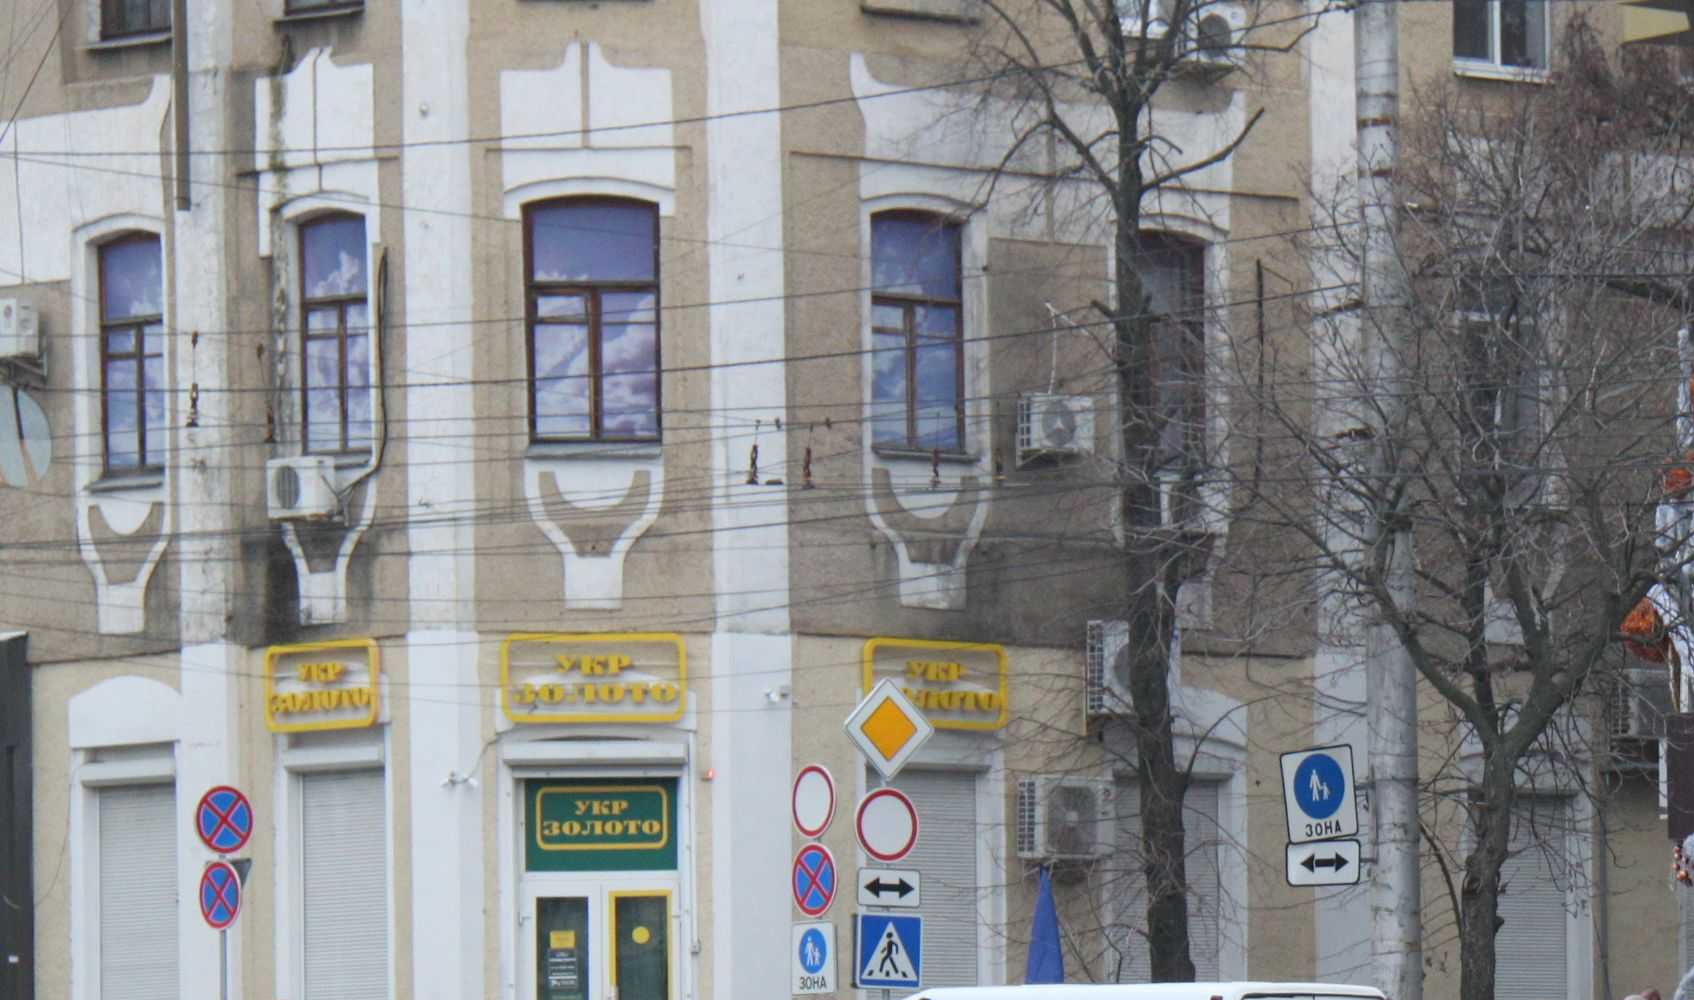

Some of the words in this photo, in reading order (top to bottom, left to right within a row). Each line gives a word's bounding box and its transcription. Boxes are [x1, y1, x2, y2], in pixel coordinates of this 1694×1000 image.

[298, 662, 345, 682] УКР
[553, 655, 634, 676] УКР
[512, 682, 677, 705] ЗОЛОТО
[901, 687, 1000, 713] ЛОТО
[575, 799, 629, 816] УКР
[543, 820, 661, 836] ЗОЛОТО
[1304, 819, 1342, 838] ЗОНА
[799, 975, 828, 990] ЗОНА
